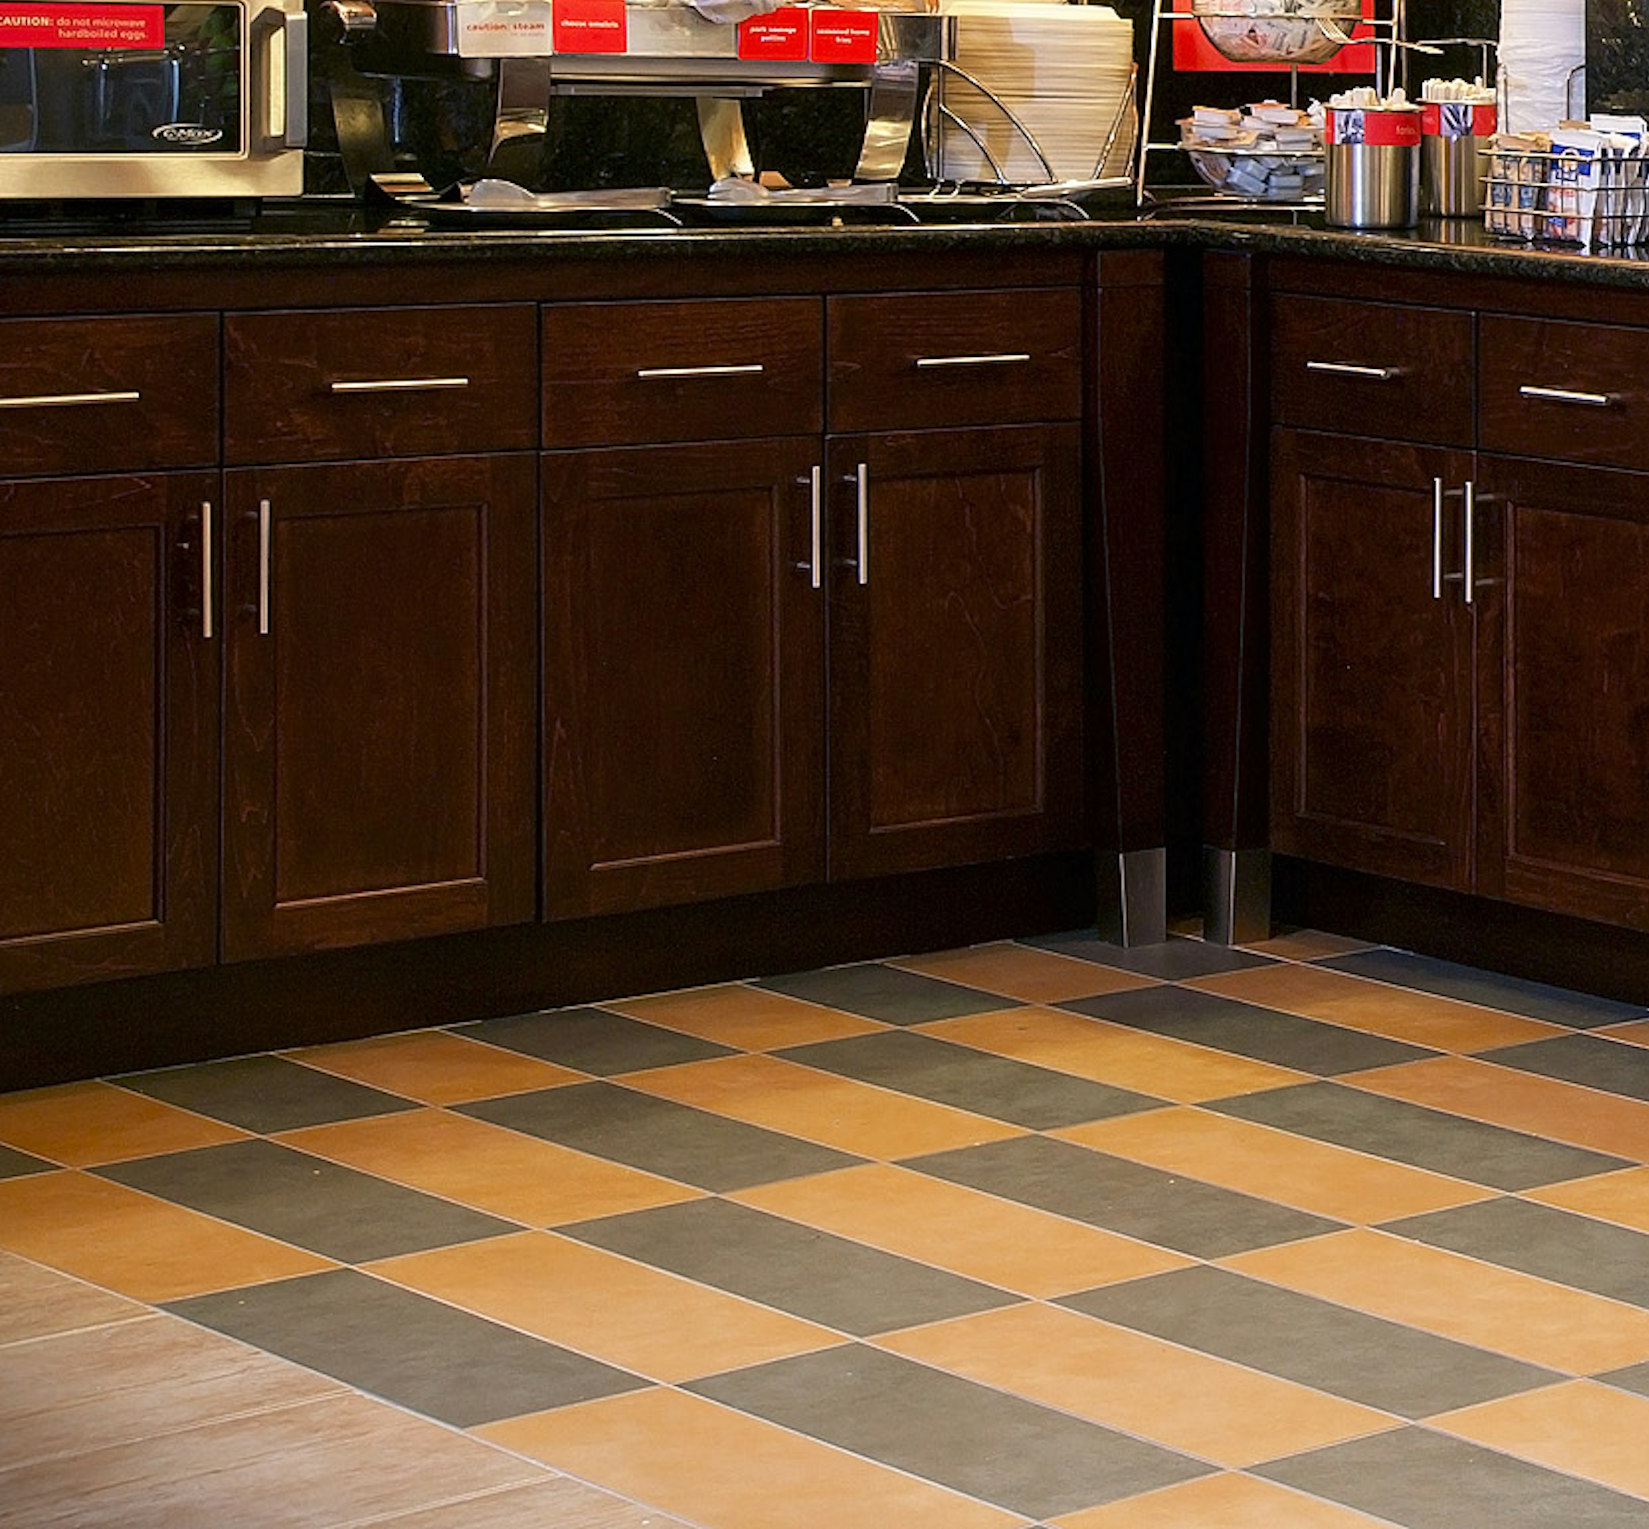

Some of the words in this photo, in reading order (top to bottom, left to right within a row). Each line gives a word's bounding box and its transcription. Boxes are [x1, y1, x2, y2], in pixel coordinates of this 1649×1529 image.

[56, 17, 70, 27] do
[72, 17, 90, 27] not
[92, 17, 146, 28] microwave
[58, 28, 118, 39] hardboiled
